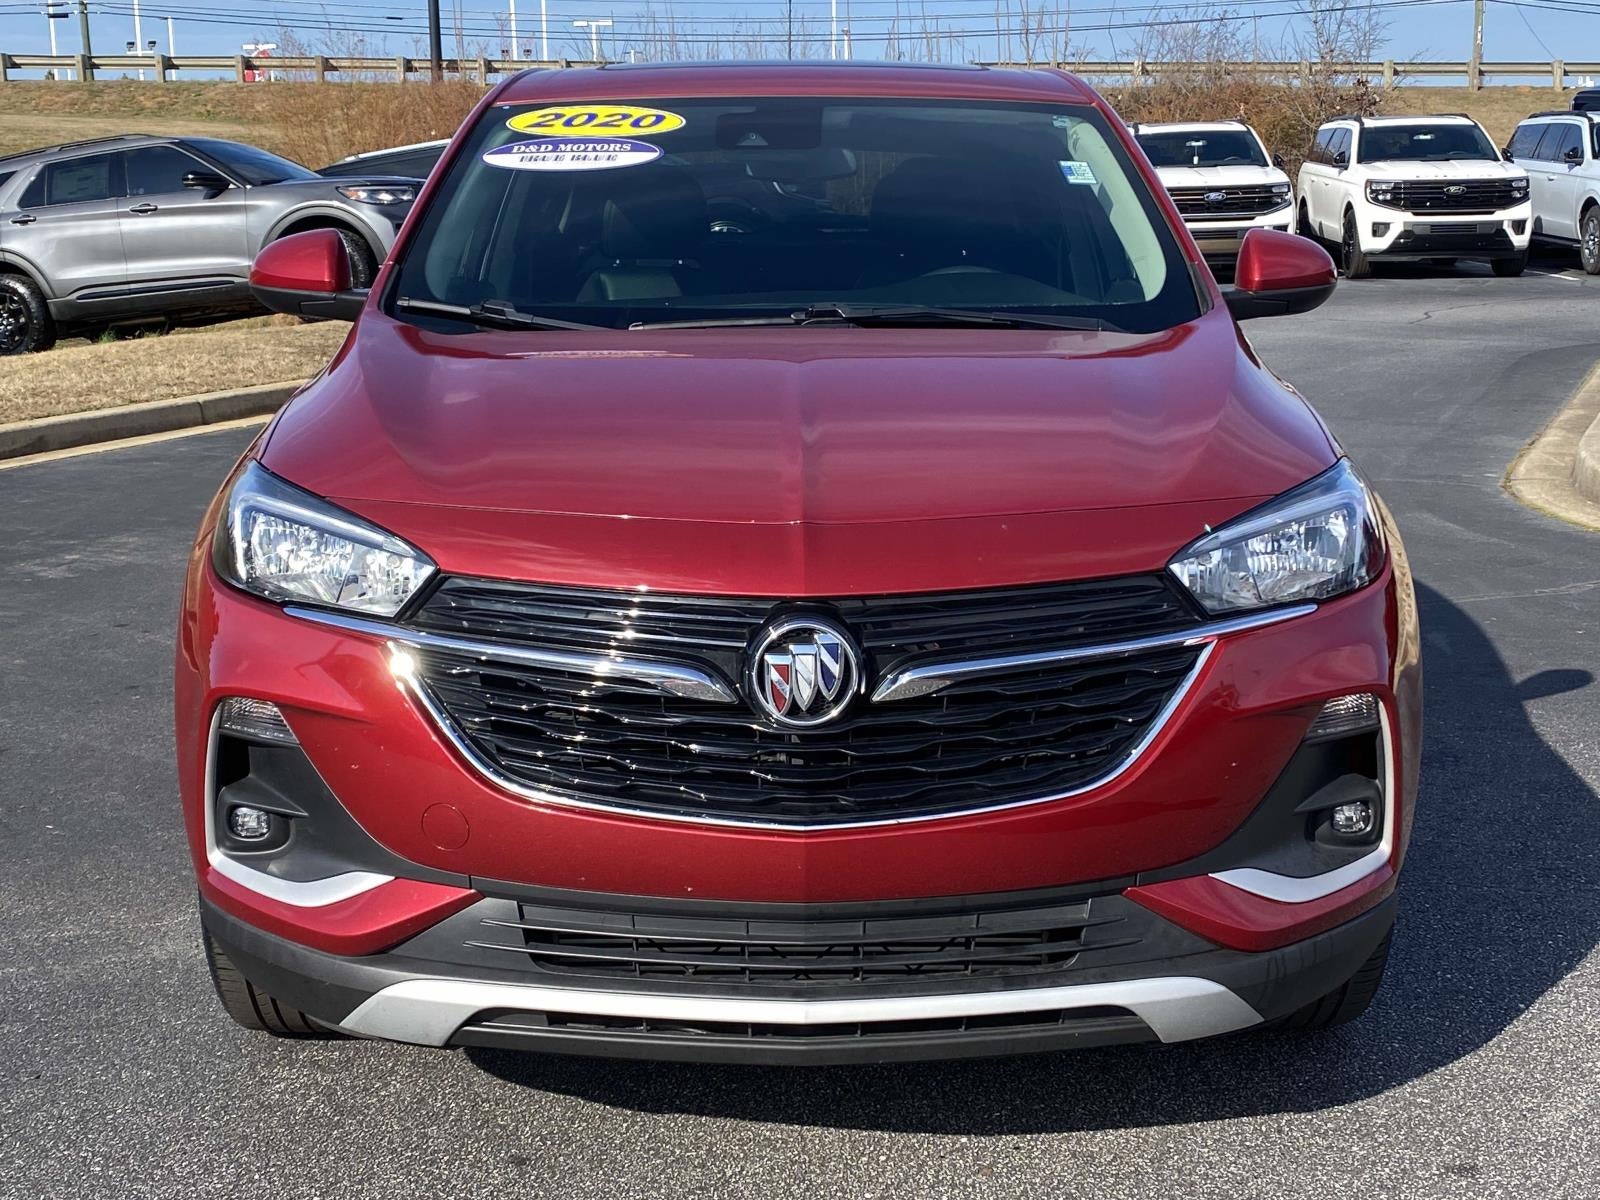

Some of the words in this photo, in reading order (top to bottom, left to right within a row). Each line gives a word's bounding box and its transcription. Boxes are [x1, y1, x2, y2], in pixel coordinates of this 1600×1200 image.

[525, 112, 666, 129] 2020
[512, 144, 553, 153] D&D
[556, 143, 632, 152] MOTORS
